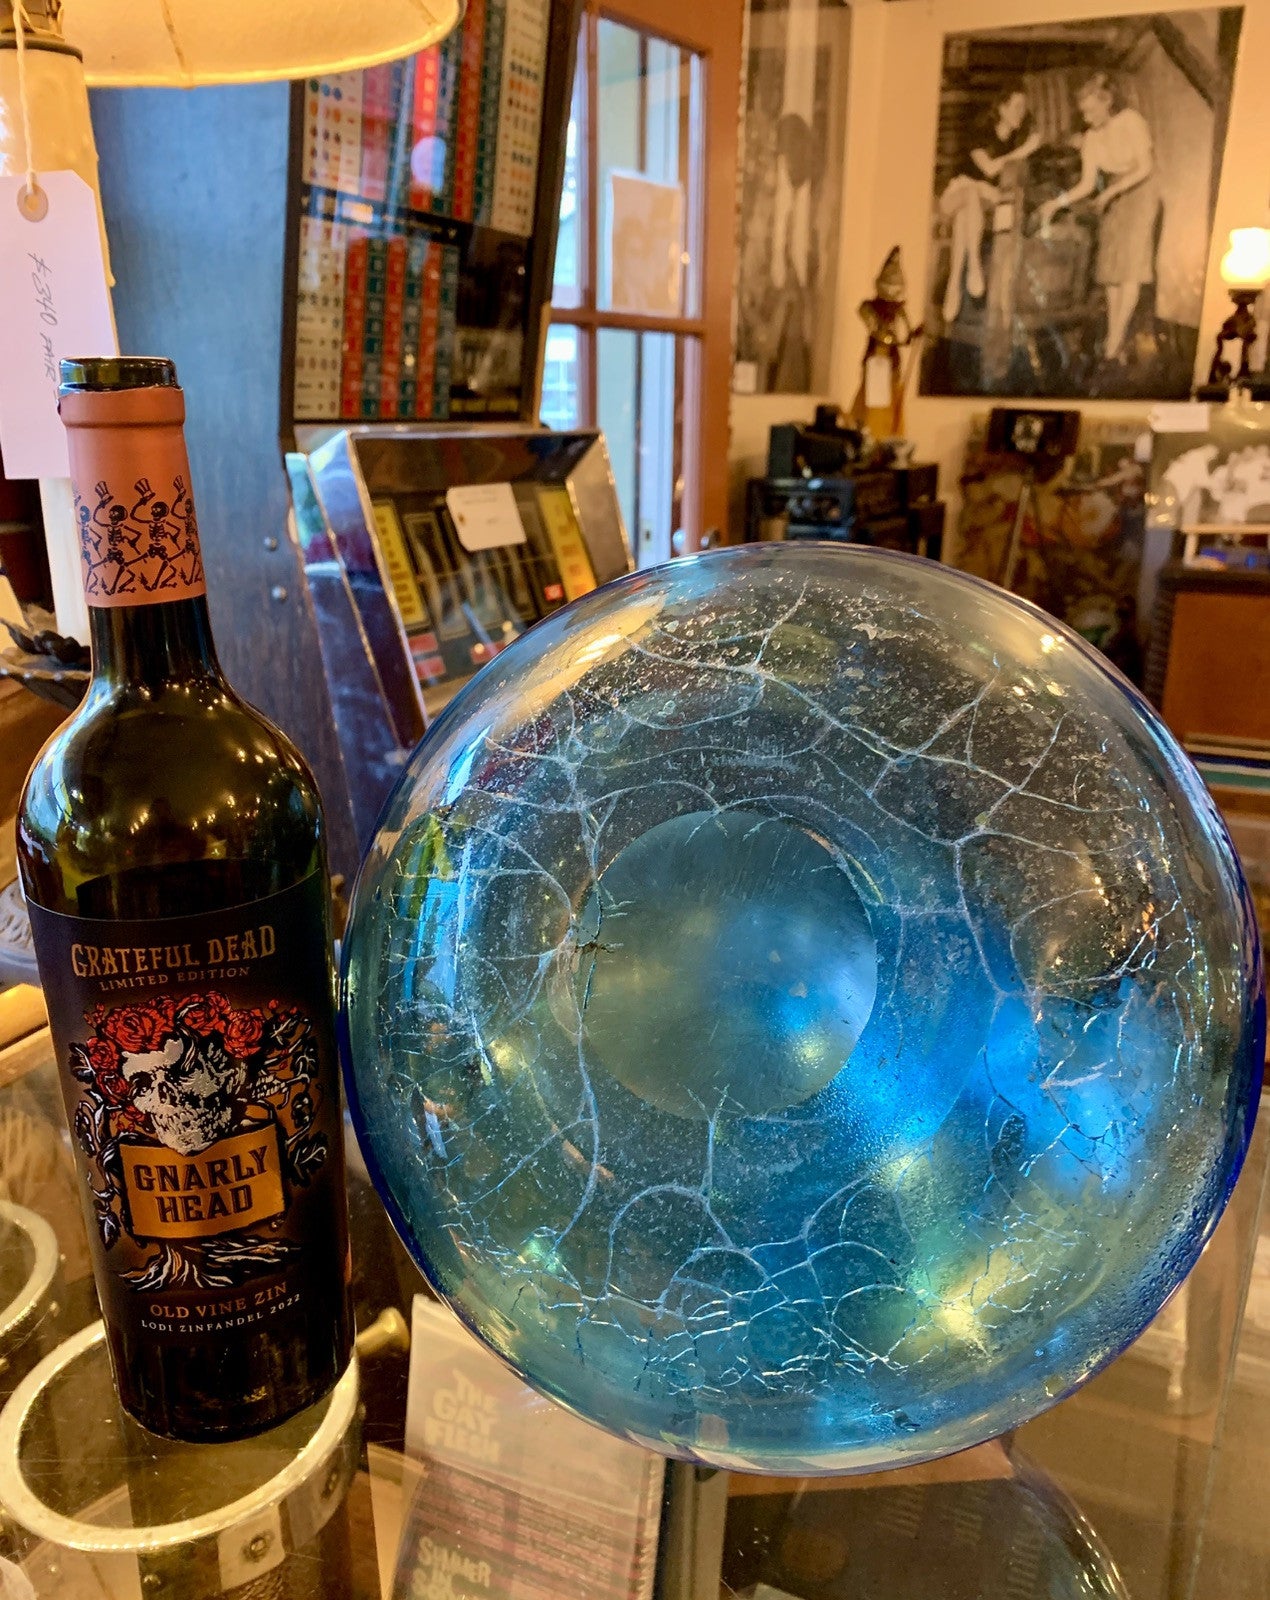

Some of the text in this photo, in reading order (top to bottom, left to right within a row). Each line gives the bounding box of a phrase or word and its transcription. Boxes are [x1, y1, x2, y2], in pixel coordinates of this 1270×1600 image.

[71, 925, 276, 978] GRATEFUL DEAD
[101, 967, 251, 991] LIMITED EDITION
[133, 1146, 268, 1223] GNARLY HEAD
[141, 1293, 301, 1332] LODI ZINFANDEL 2022
[150, 1282, 288, 1318] OLD VINE ZIN
